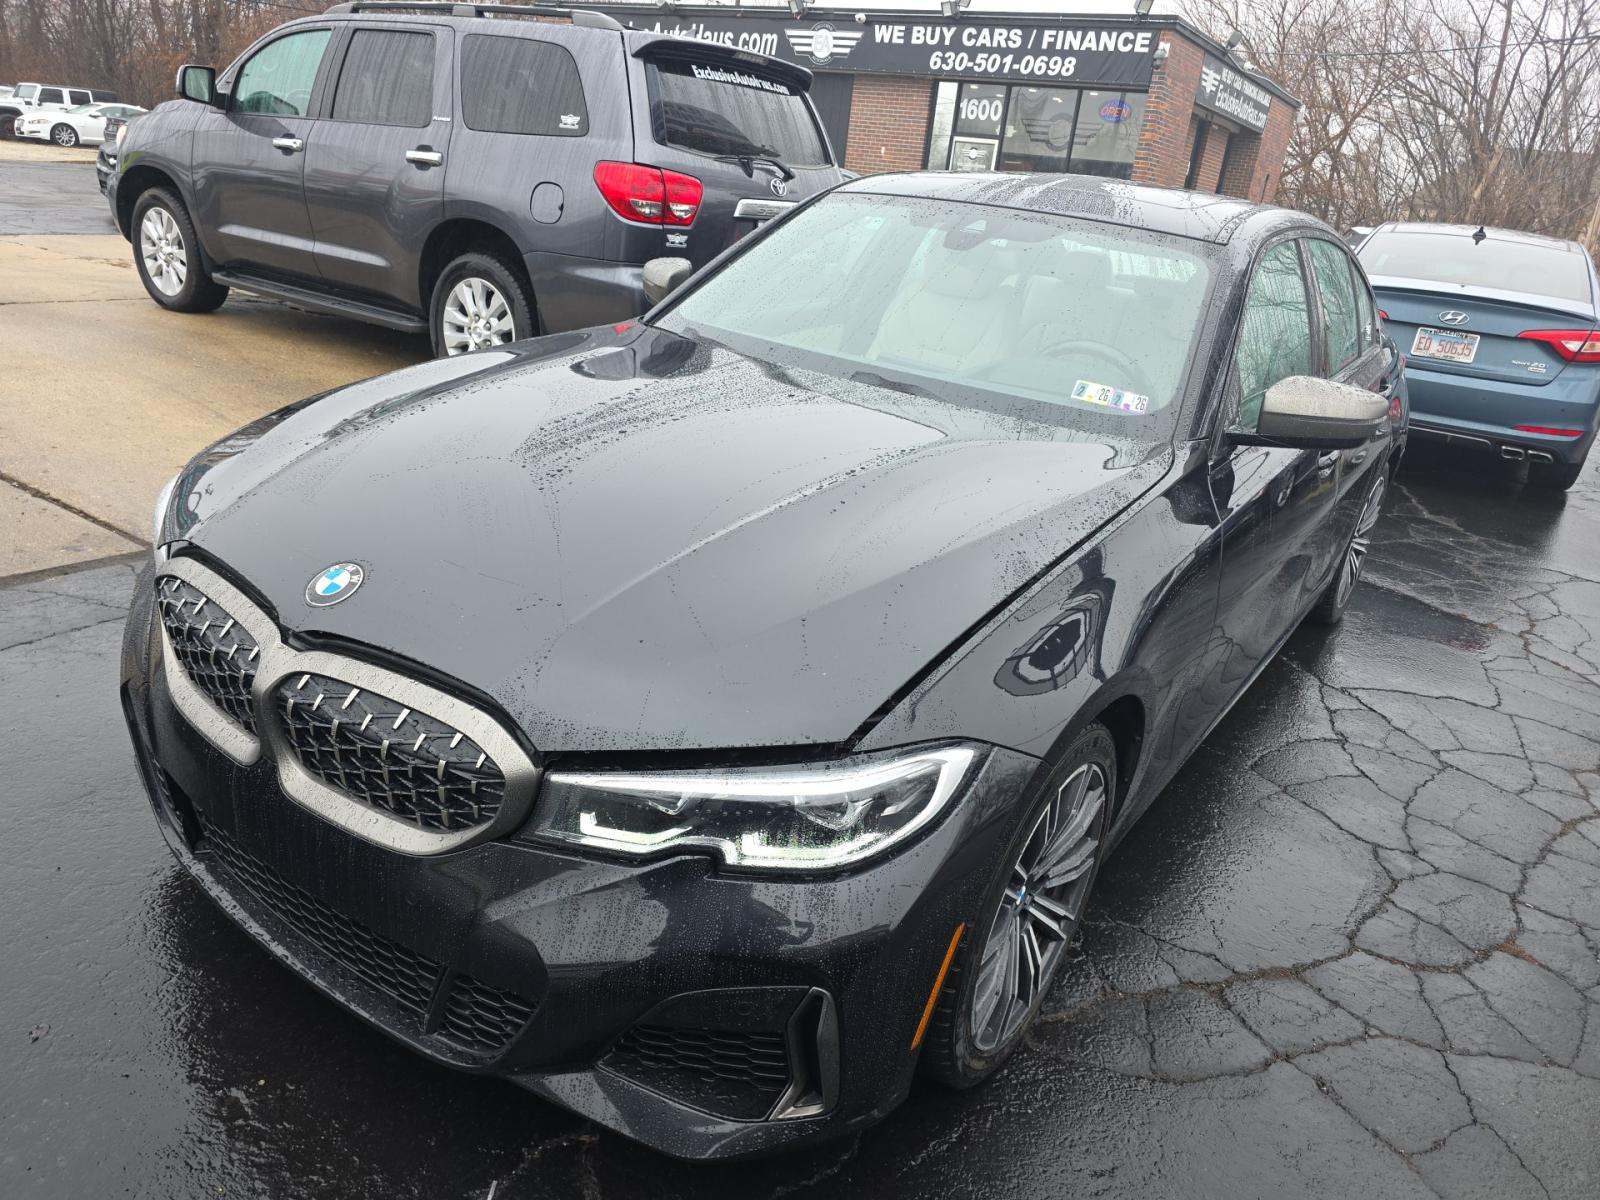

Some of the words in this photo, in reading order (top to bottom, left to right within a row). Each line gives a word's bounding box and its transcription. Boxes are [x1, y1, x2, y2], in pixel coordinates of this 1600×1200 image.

[874, 24, 906, 44] WE
[911, 26, 957, 46] BUY
[962, 27, 1023, 49] CARS
[1027, 29, 1037, 49] /
[1041, 30, 1152, 53] FINANCE
[929, 51, 1077, 77] 630-501-0698
[959, 98, 1003, 121] 1600
[1101, 105, 1130, 119] OPEN
[1098, 387, 1111, 402] 26
